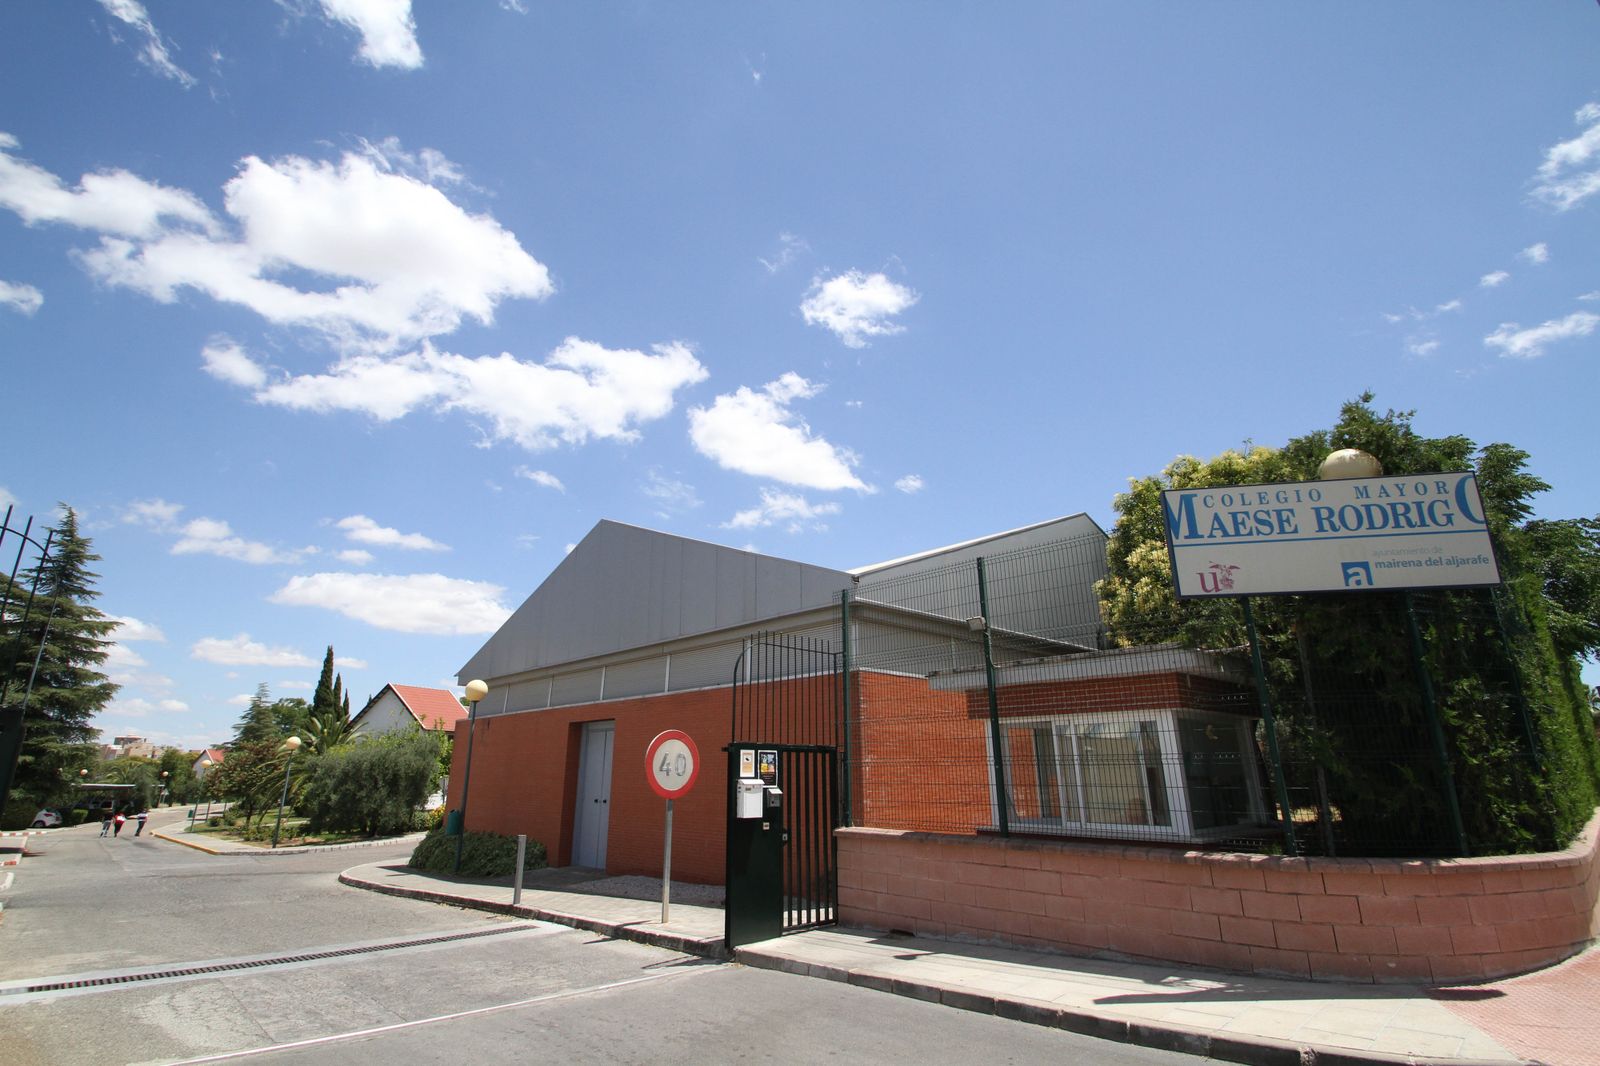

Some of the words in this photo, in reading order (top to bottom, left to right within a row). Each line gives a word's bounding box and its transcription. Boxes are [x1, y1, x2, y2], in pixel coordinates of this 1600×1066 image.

[1203, 488, 1321, 508] COLEGIO
[1354, 481, 1449, 499] MAYOR
[1165, 493, 1300, 539] MAESE
[1375, 558, 1422, 569] mairena
[1425, 556, 1443, 567] del
[1446, 554, 1489, 568] aljarafe
[1431, 546, 1443, 555] de
[659, 753, 687, 777] 40
